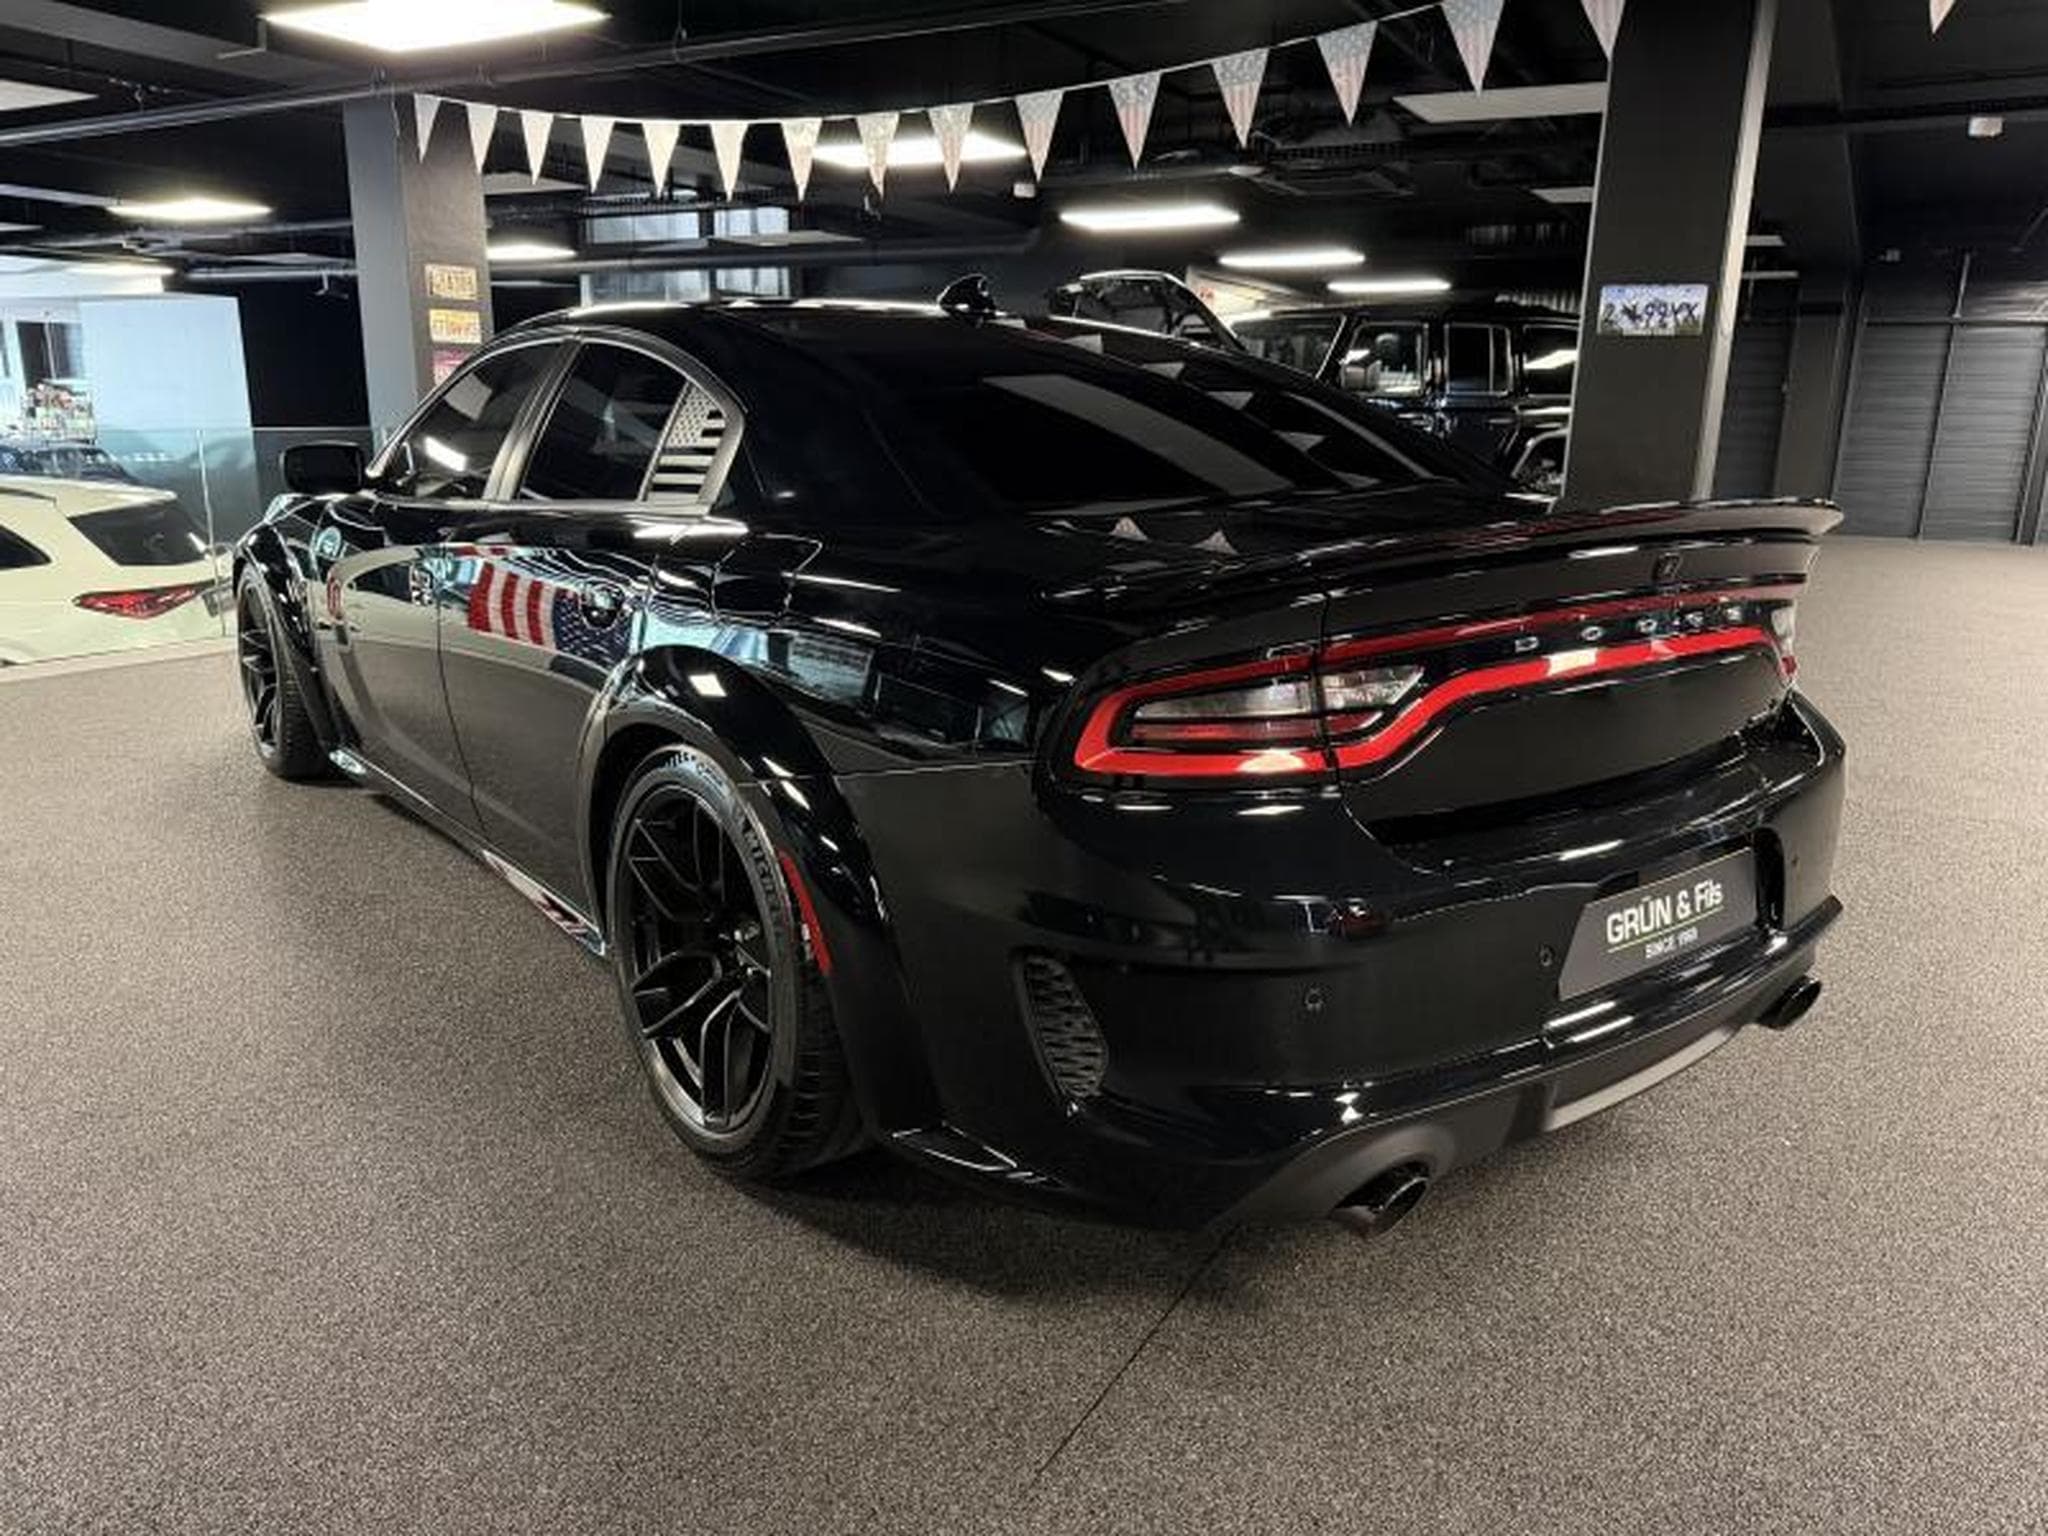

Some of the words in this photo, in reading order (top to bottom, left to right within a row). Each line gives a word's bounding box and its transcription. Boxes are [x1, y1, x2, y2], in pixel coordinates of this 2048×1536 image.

[1606, 895, 1671, 945] GRÜN
[1676, 889, 1692, 920] &
[1694, 879, 1724, 913] Fils
